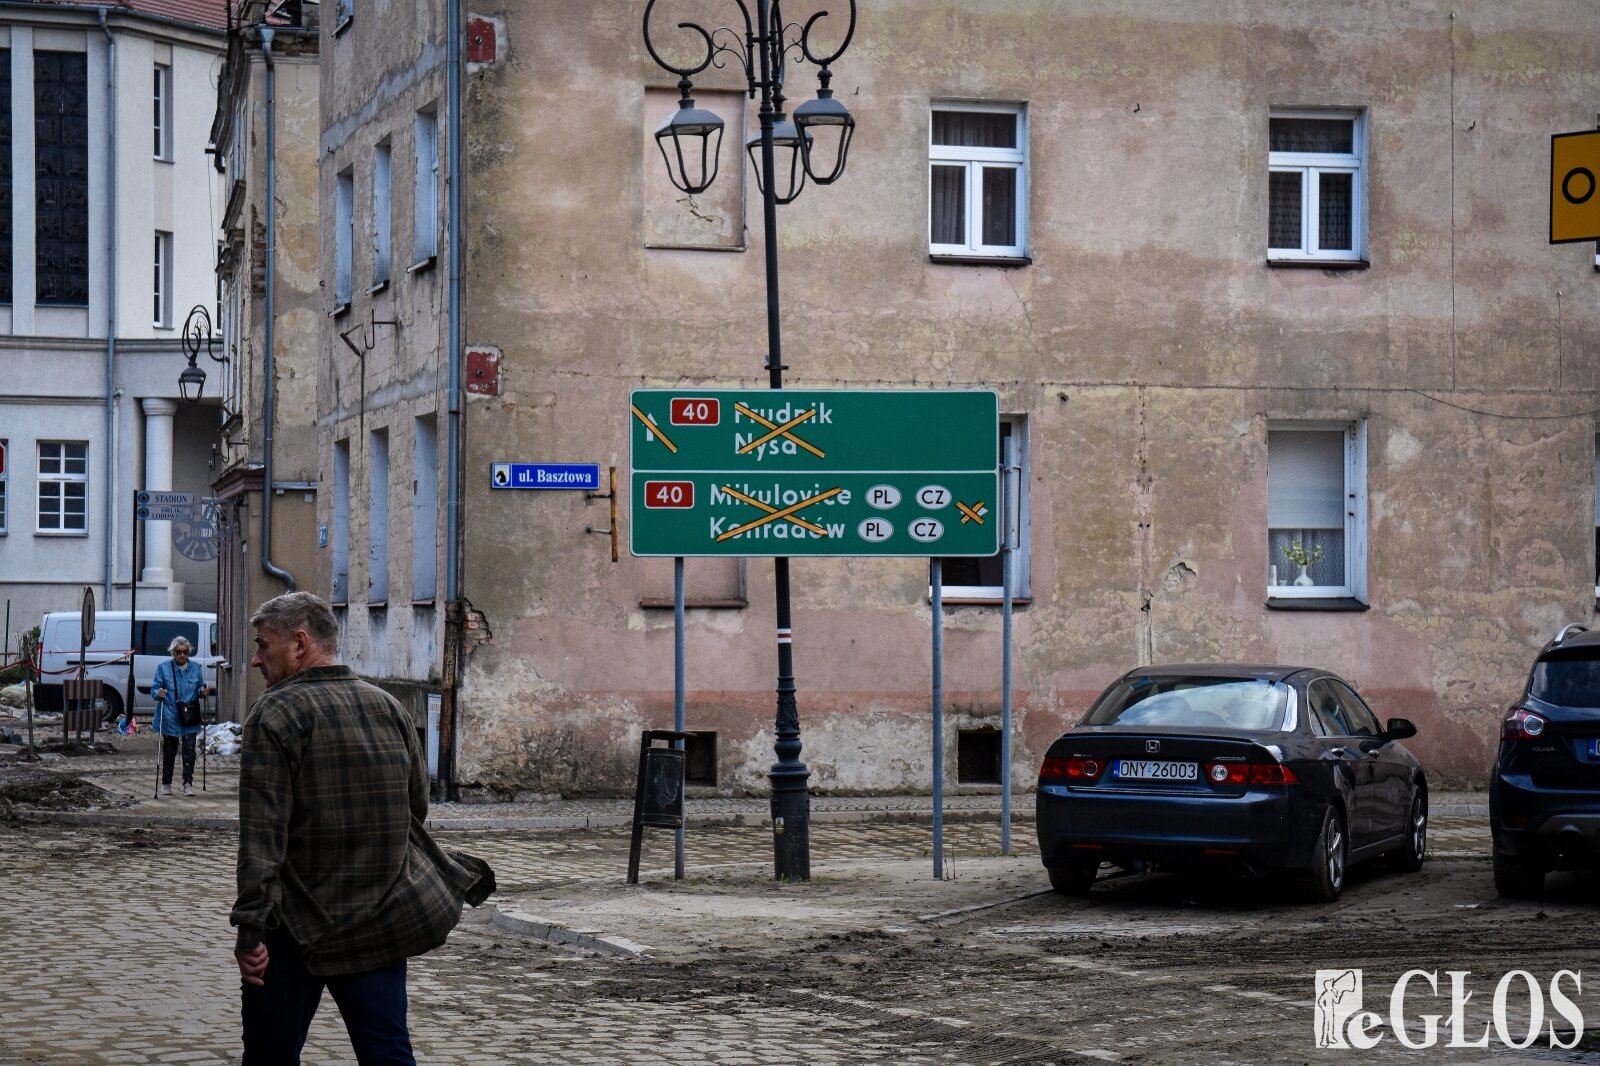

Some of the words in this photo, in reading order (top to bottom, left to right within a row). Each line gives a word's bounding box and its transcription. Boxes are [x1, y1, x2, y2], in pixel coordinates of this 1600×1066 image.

[683, 403, 709, 420] 40
[735, 432, 797, 461] Nysa
[519, 469, 533, 482] ul.
[537, 469, 592, 483] Basztowa
[155, 495, 187, 503] STADION
[656, 486, 683, 503] 40
[710, 483, 851, 506] Mikulovice
[874, 490, 892, 504] PL
[921, 490, 944, 504] CZ
[866, 523, 884, 537] PL
[914, 523, 936, 537] CZ
[1120, 761, 1147, 777] ONY
[1152, 763, 1196, 778] 26003
